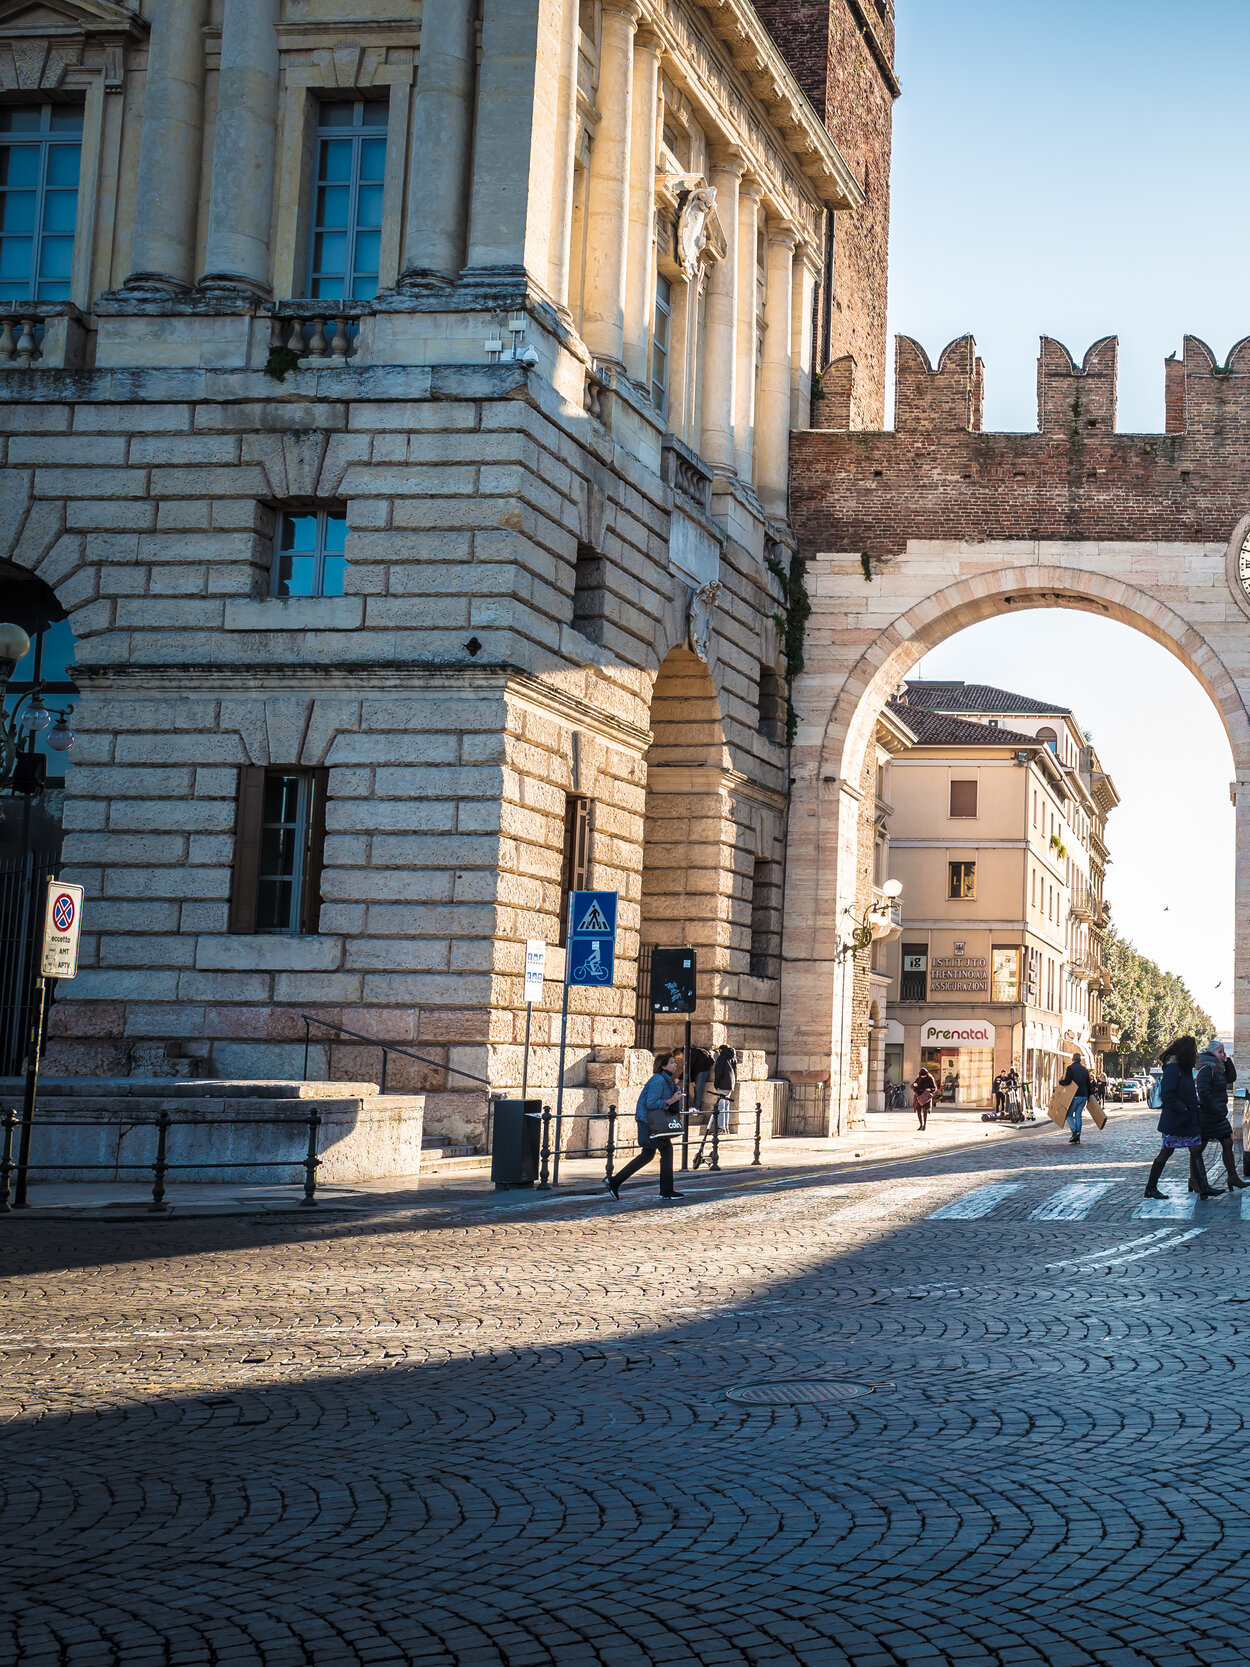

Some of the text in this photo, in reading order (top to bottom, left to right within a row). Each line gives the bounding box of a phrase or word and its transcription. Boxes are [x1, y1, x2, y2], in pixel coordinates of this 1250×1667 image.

[51, 935, 71, 943] eccetto
[931, 958, 986, 967] ISTITUTO
[930, 970, 974, 979] TRENTINO
[930, 981, 987, 991] ASSICURAZIONI
[668, 1119, 682, 1129] coin
